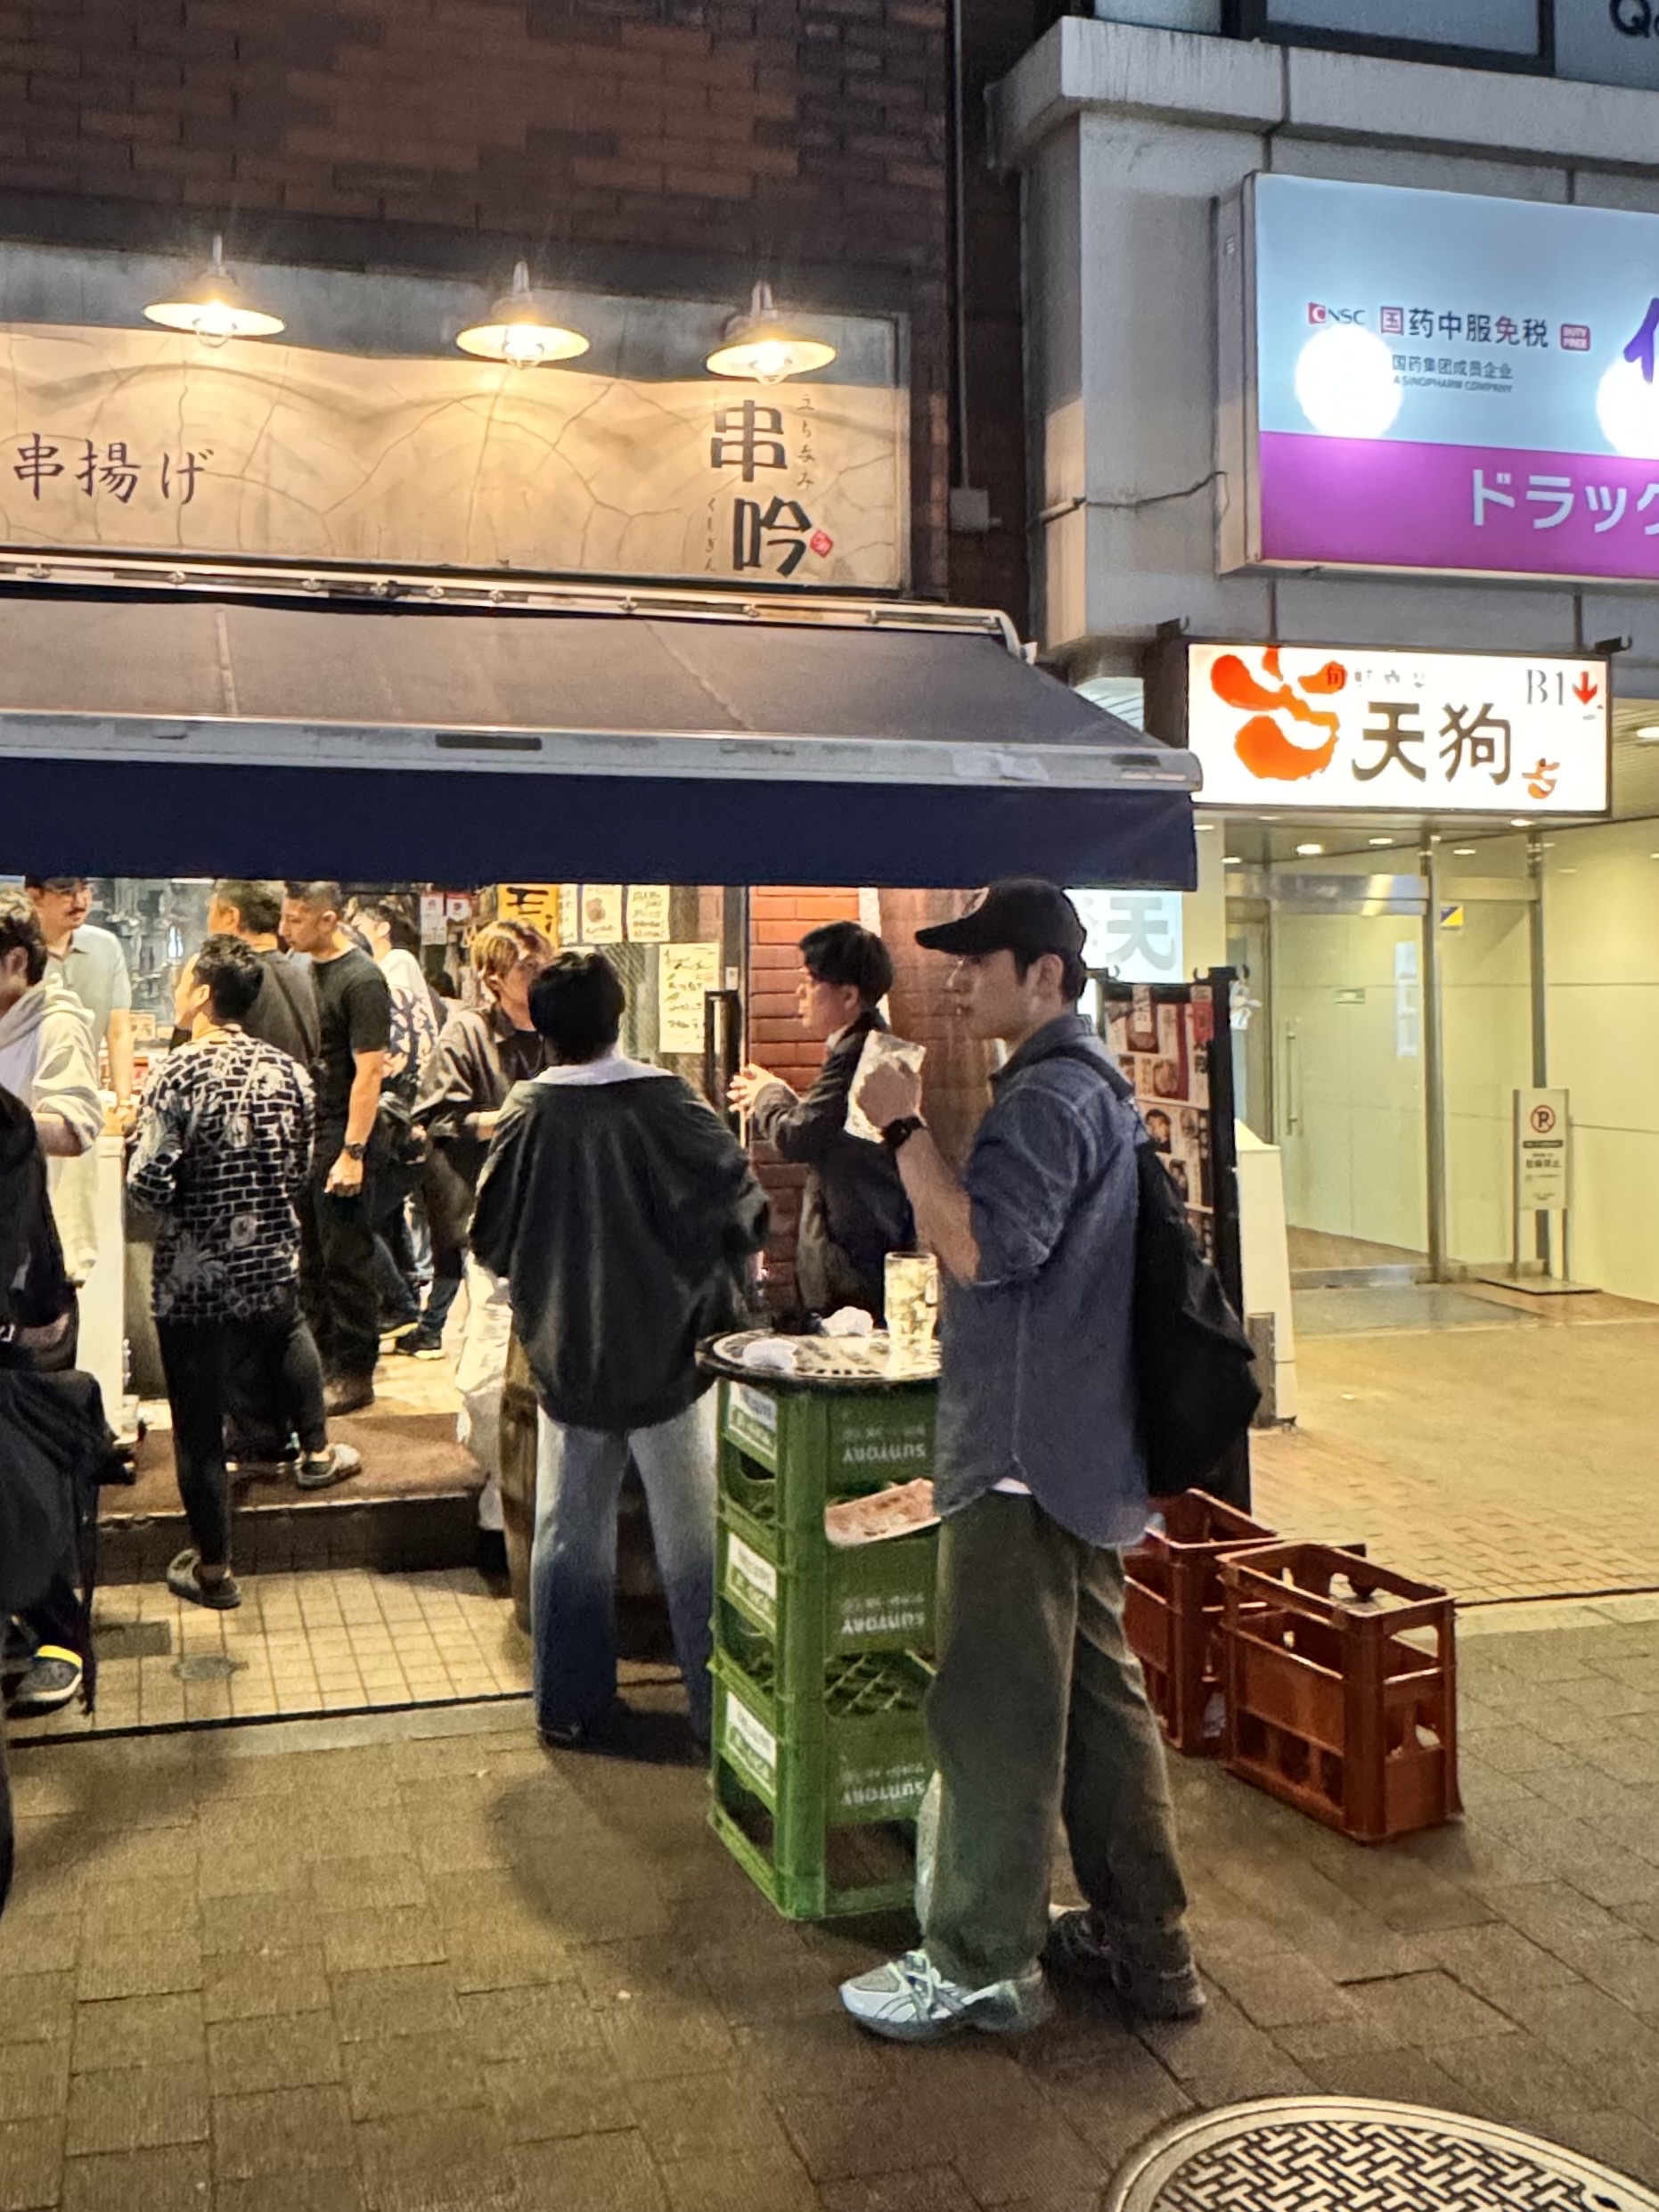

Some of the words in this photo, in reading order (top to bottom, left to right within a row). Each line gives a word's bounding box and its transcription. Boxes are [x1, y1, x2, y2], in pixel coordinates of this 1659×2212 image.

[1609, 0, 1659, 38] Q
[1380, 306, 1549, 348] 国药中服免税
[13, 432, 215, 505] 串揚げ
[711, 399, 813, 578] 串吟
[1527, 669, 1565, 706] B1
[1352, 701, 1511, 785] 天狗
